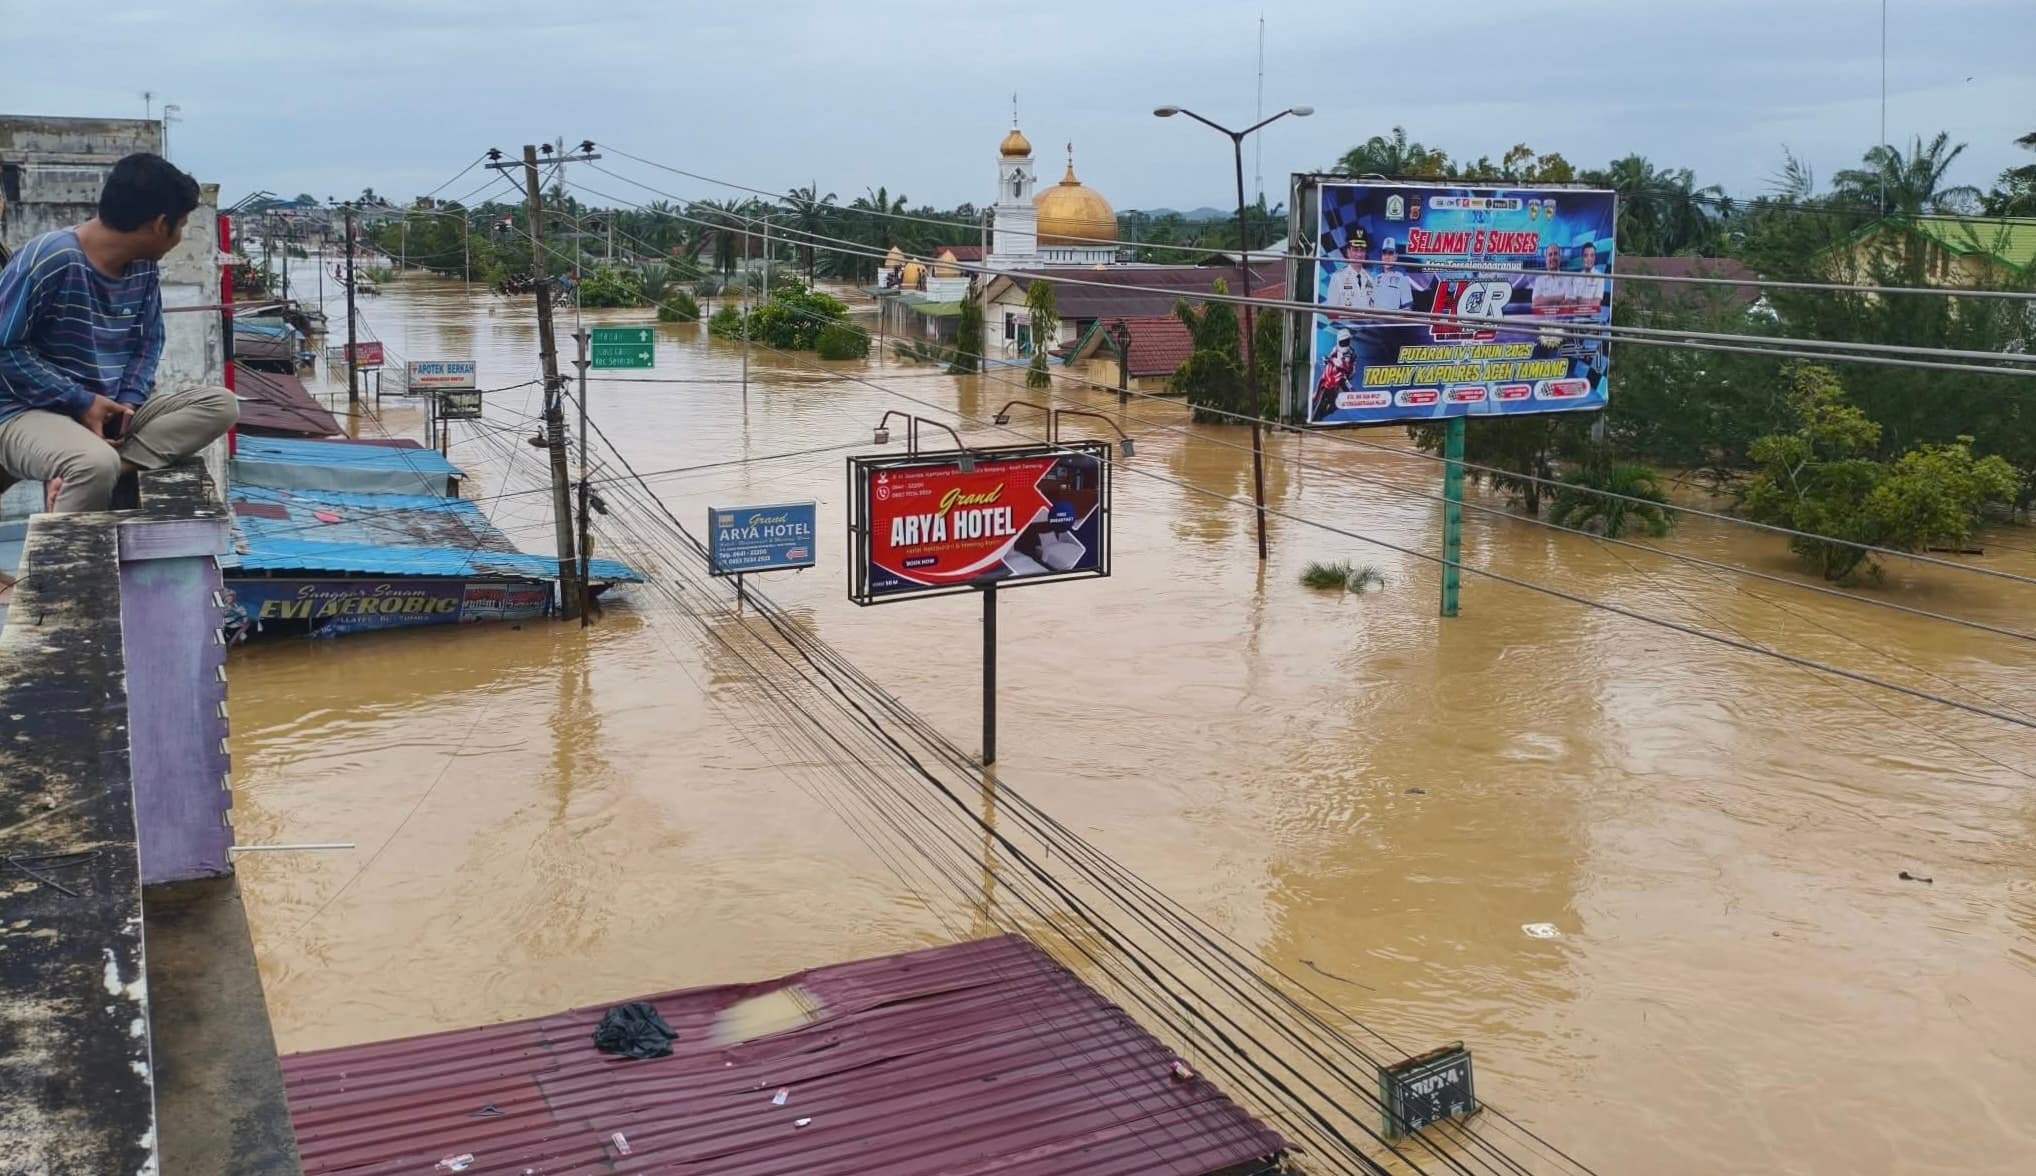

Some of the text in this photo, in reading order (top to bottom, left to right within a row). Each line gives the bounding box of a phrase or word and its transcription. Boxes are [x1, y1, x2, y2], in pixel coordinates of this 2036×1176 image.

[1407, 227, 1539, 254] SELAMAT & SUKSES
[1400, 346, 1453, 361] PUTARAN
[1471, 345, 1503, 359] TAHUN
[1505, 344, 1532, 358] 2025
[418, 363, 474, 374] APOTEK BERKAH
[1364, 360, 1567, 386] TROPHY KAPOLRES ACEH TAMIANG
[940, 482, 1004, 518] Grand
[749, 513, 788, 528] Grand
[890, 507, 1016, 548] ARYA HOTEL
[720, 523, 811, 541] ARYA HOTEL
[906, 559, 921, 567] BOOK
[375, 583, 426, 597] Senam
[258, 599, 313, 618] EVI
[315, 596, 459, 618] AEROBIC
